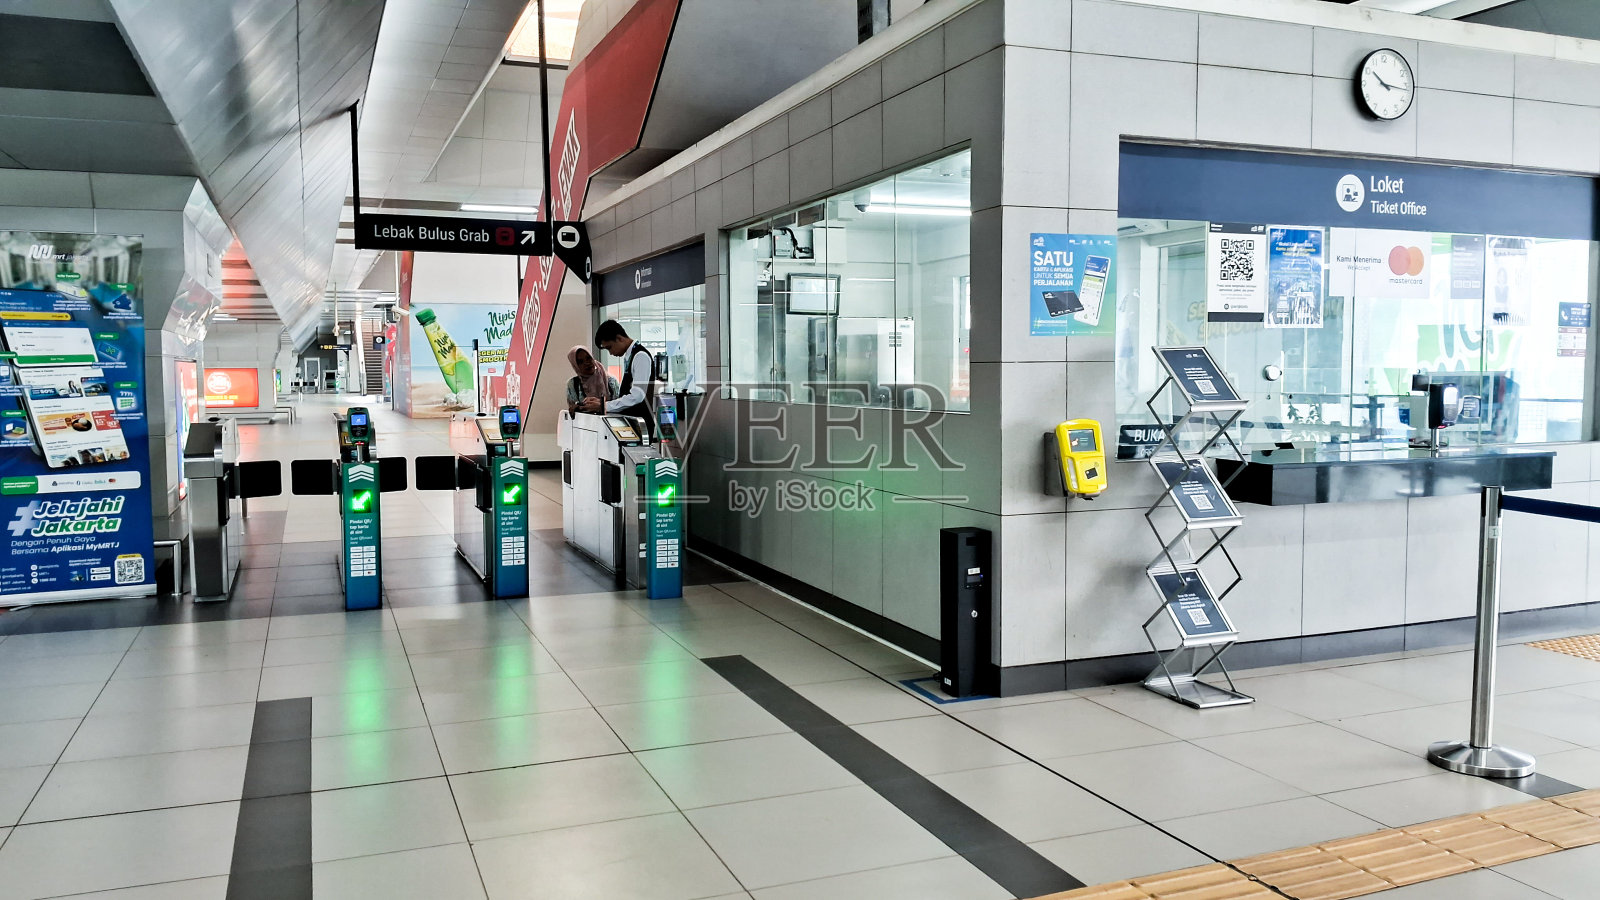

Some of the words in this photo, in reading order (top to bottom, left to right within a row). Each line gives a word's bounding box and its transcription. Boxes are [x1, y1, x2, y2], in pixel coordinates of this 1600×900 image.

[1370, 176, 1405, 195] Loket
[1370, 200, 1399, 215] Ticket
[1400, 201, 1427, 216] Office
[374, 224, 414, 240] Lebak
[418, 226, 455, 242] Bulus
[459, 228, 490, 243] Grab
[1033, 250, 1074, 266] SATU
[487, 310, 516, 327] Nipis
[484, 322, 513, 345] Mad
[1134, 428, 1166, 442] BUKA
[31, 517, 123, 537] Jakarta
[11, 539, 45, 549] Dengan
[46, 537, 72, 545] Penuh
[73, 536, 96, 544] Gaya
[11, 546, 49, 556] Bersama
[51, 543, 85, 554] Aplikasi
[86, 541, 120, 551] MyMRTJ
